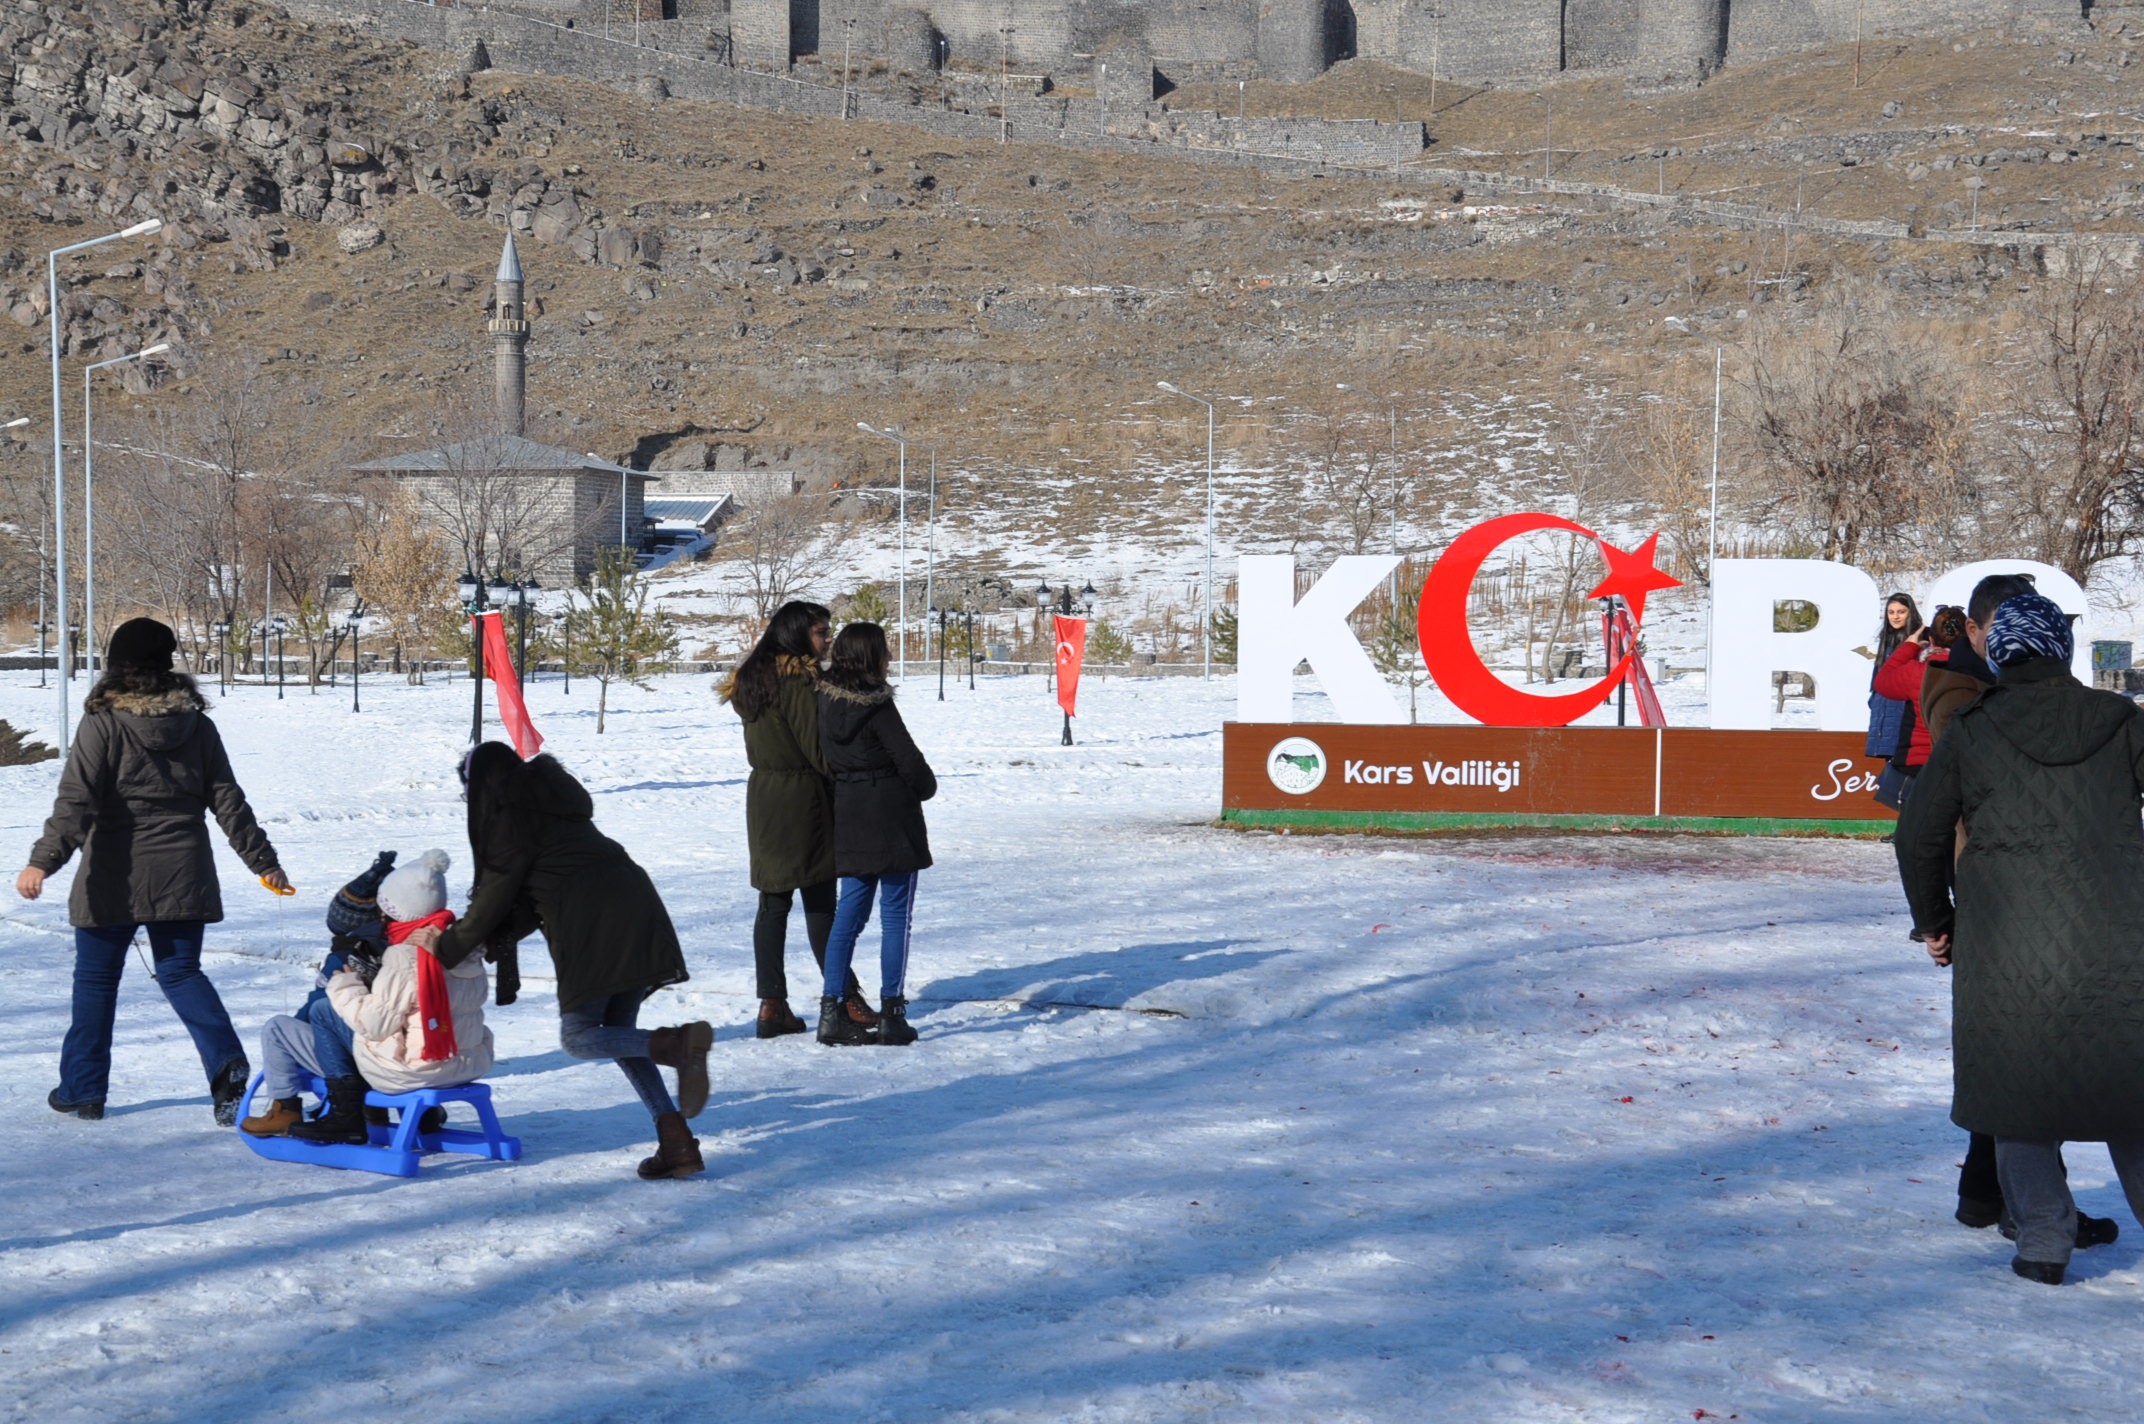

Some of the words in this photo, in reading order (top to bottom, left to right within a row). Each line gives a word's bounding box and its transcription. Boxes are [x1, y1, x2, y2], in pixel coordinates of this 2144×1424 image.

[1344, 760, 1414, 785] Kars
[1422, 760, 1521, 793] Valiliği
[1811, 758, 1880, 801] Ser
